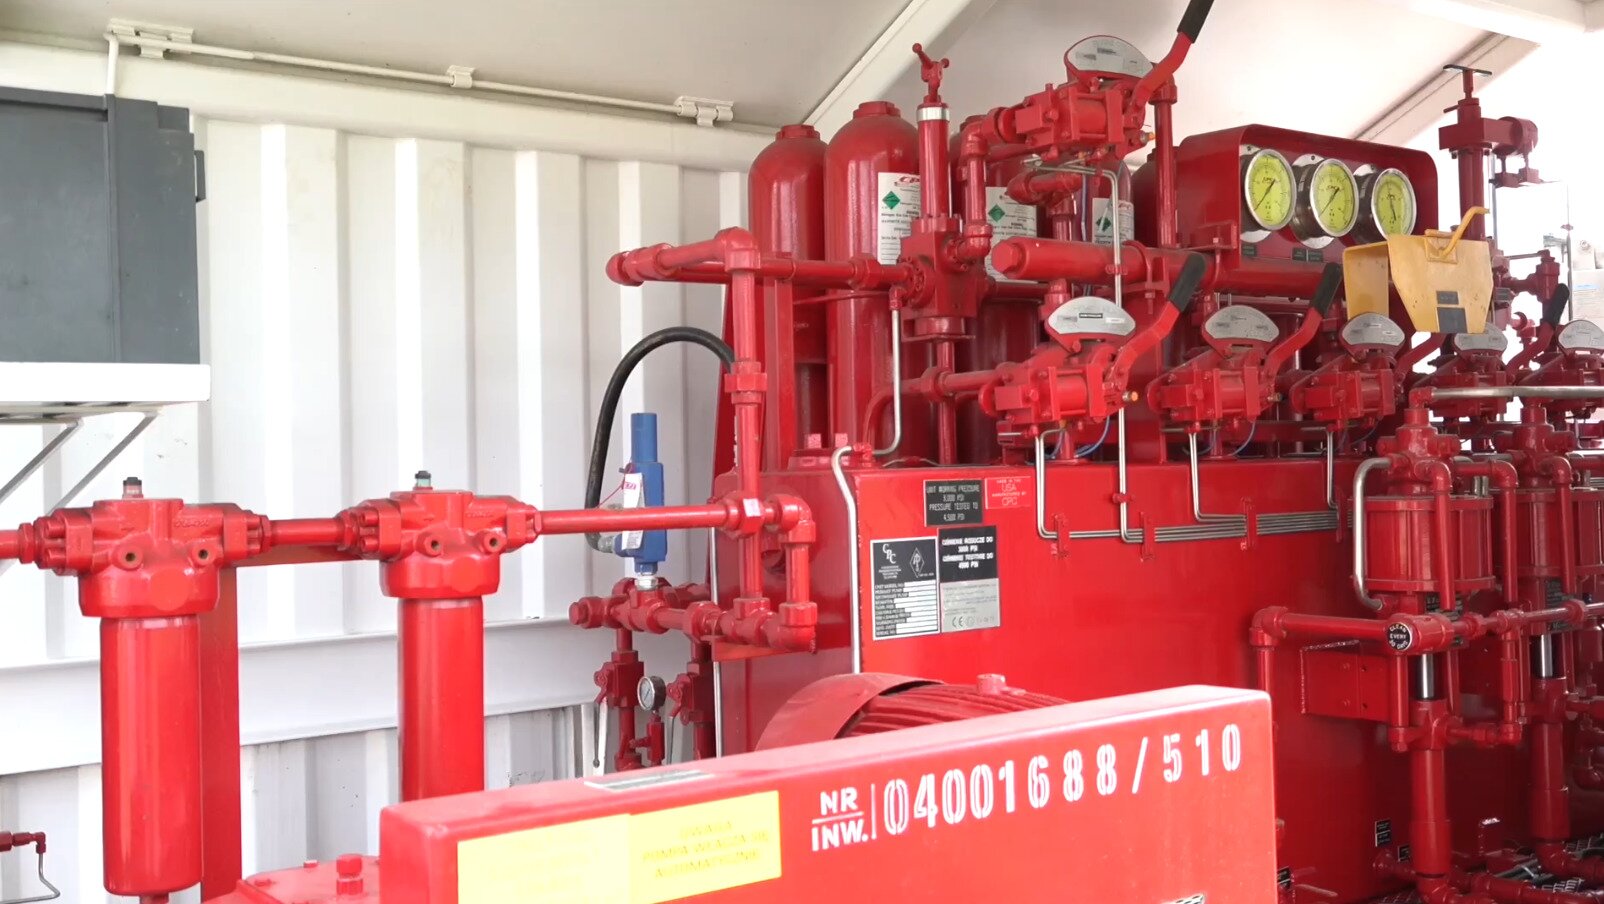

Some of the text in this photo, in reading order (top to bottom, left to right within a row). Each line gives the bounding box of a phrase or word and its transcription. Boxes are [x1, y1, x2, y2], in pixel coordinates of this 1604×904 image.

[1001, 483, 1017, 492] USA
[929, 502, 952, 510] PRESSURE
[973, 501, 979, 509] TO
[1390, 624, 1406, 633] CLEAN
[820, 786, 859, 817] NR
[811, 819, 869, 852] INW.
